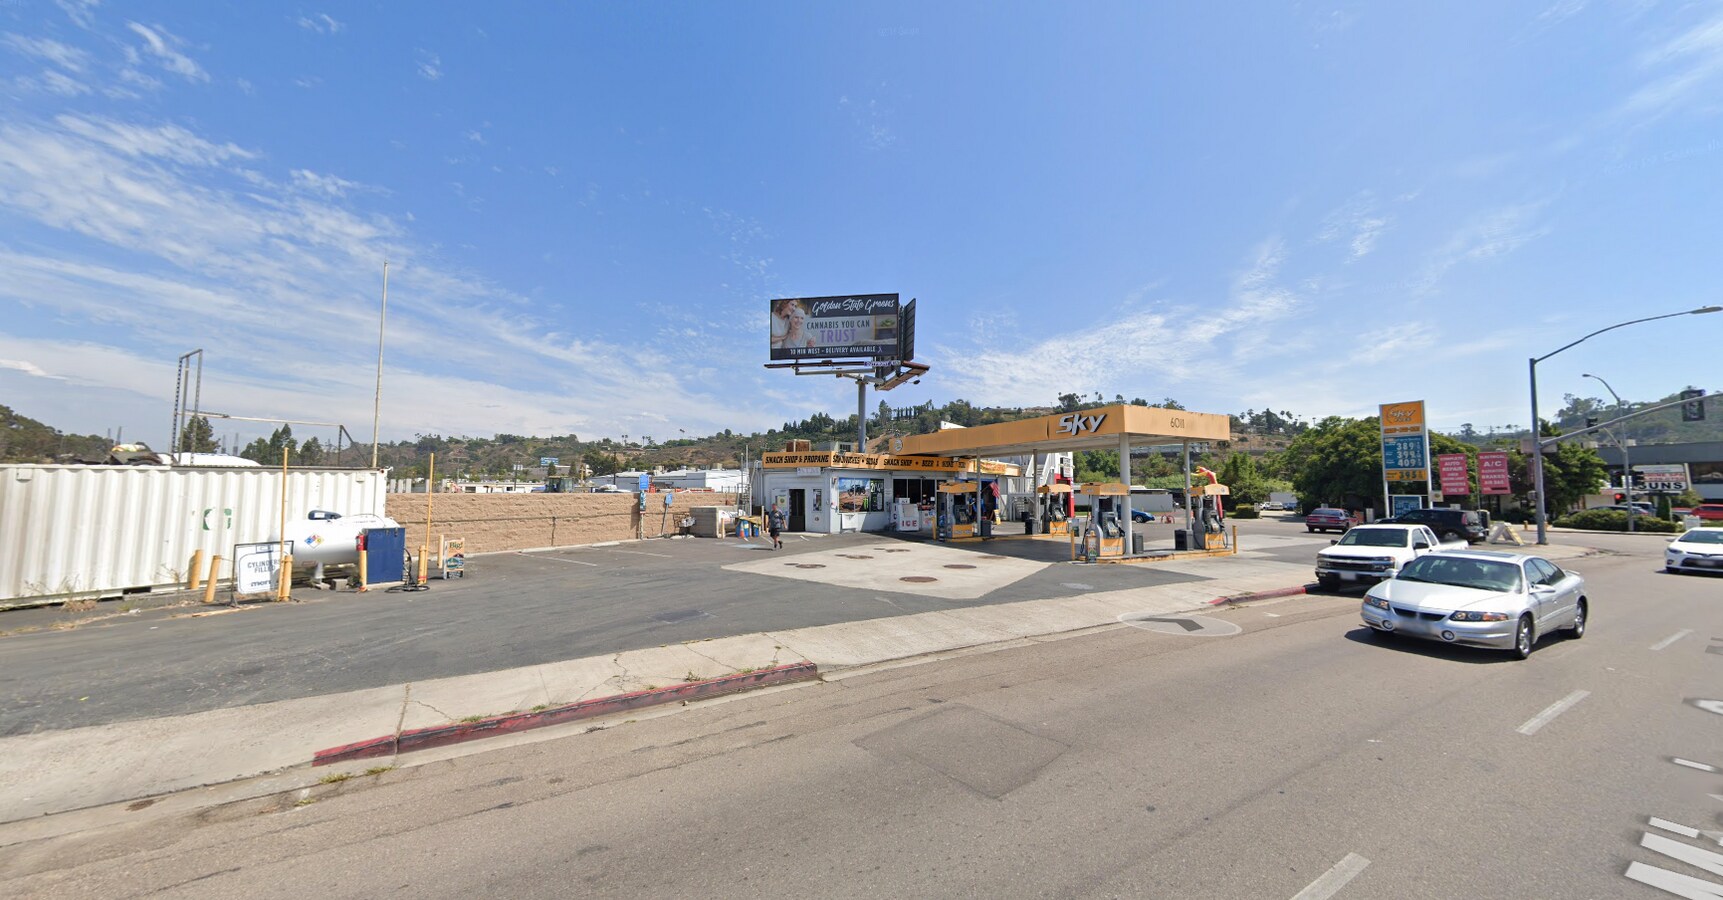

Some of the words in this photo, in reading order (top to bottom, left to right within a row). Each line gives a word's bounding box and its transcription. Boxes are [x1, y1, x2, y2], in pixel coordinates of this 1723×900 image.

[812, 301, 841, 316] Golden
[842, 299, 864, 311] State
[865, 299, 895, 313] Greens
[806, 320, 839, 330] CANNABIS
[841, 320, 855, 329] YOU
[857, 319, 870, 328] CAN
[820, 329, 856, 343] TRUST
[826, 346, 848, 354] DELIVERY
[849, 345, 876, 353] AVAILABLE
[803, 454, 830, 463] PROPANE
